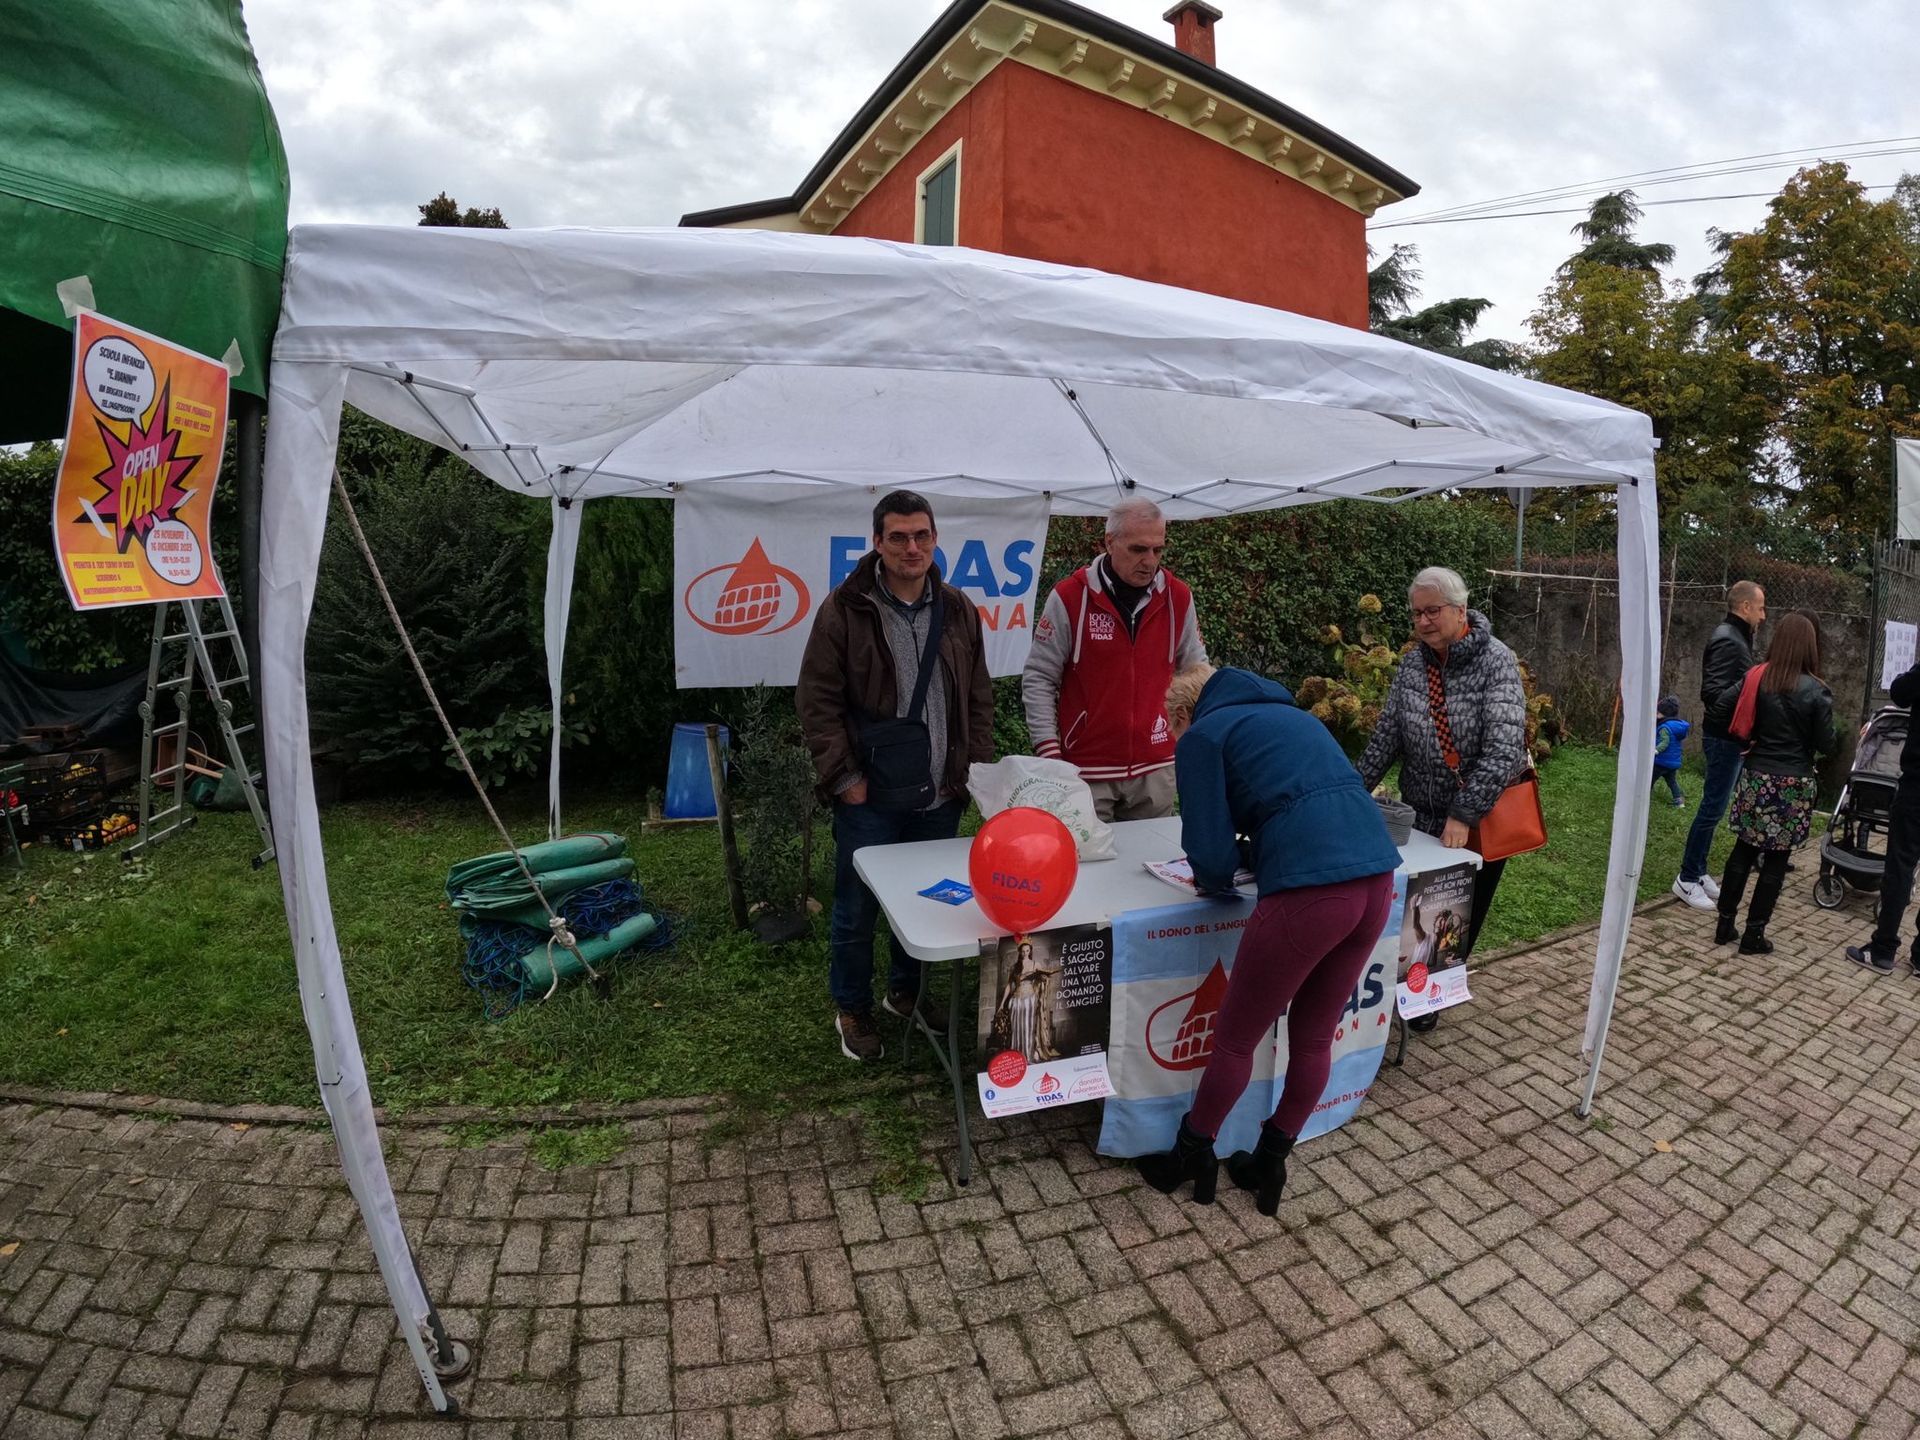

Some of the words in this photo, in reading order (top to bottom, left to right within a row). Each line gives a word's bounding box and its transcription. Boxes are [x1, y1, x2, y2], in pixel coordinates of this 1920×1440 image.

[99, 346, 121, 362] SCUOLA
[121, 353, 145, 370] INFANZIA
[123, 443, 159, 480] OPEN
[120, 461, 171, 529] DAY
[158, 542, 179, 552] DICEMBRE
[829, 536, 1036, 598] FAS
[1089, 612, 1113, 622] 100%
[1089, 620, 1115, 629] PURO
[1091, 633, 1114, 641] FIDAS
[1151, 731, 1168, 741] FIDAS
[992, 872, 1042, 893] FIDAS
[1443, 880, 1457, 890] NON
[1457, 877, 1472, 889] PROVI
[1147, 930, 1157, 939] IL
[1159, 926, 1191, 938] DONO
[1194, 924, 1210, 935] DEL
[1214, 919, 1248, 932] SANGU
[1062, 942, 1067, 954] È
[1069, 939, 1104, 953] GIUSTO
[1060, 956, 1065, 966] E
[1067, 950, 1105, 965] SAGGIO
[1063, 962, 1100, 977] SALVARE
[1061, 977, 1079, 988] UNA
[1081, 974, 1101, 984] VITA
[1056, 984, 1104, 1000] DONANDO
[1056, 1001, 1063, 1010] IL
[1066, 995, 1103, 1008] SANGUE!
[1428, 996, 1443, 1006] FIDAS
[1036, 1092, 1064, 1103] FIDAS
